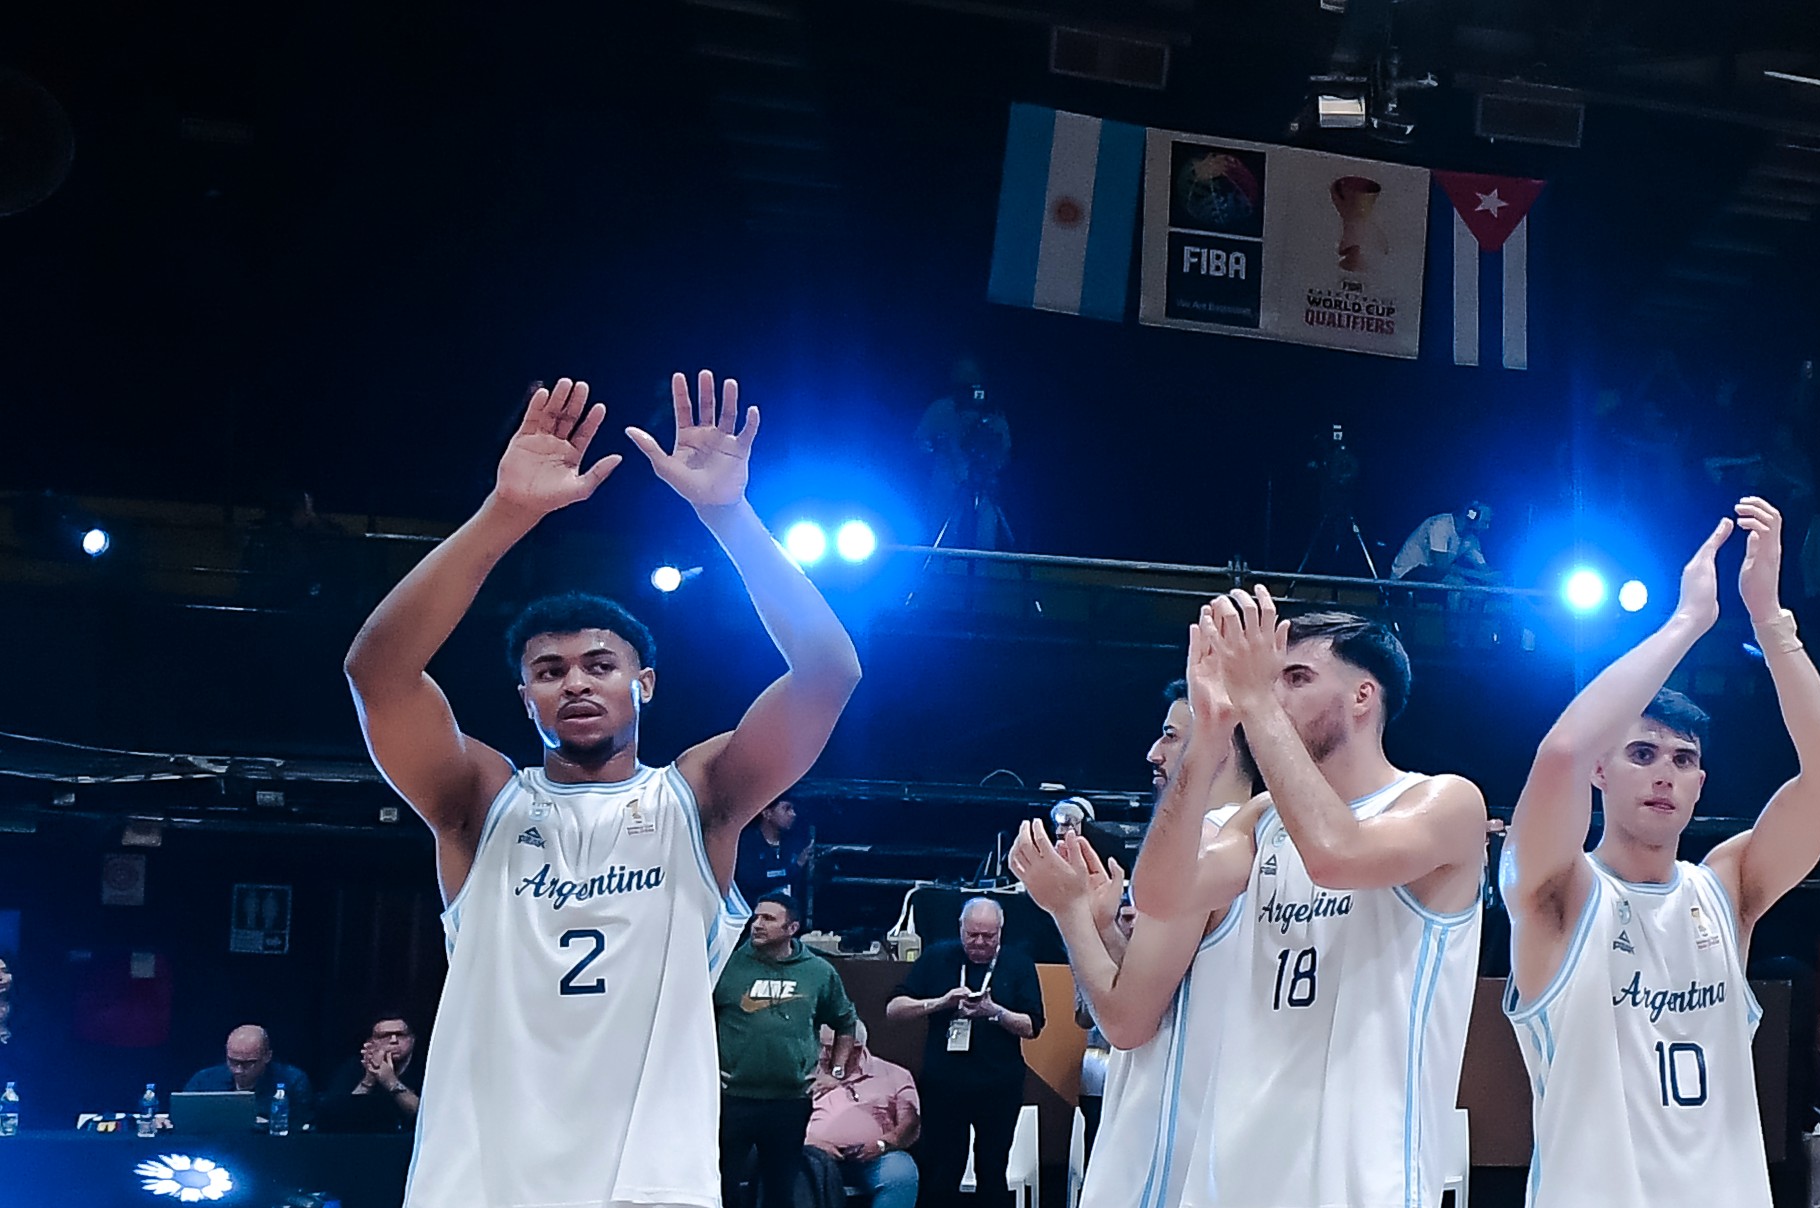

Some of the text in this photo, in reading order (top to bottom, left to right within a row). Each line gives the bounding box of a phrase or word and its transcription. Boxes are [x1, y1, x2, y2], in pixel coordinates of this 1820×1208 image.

[1183, 245, 1247, 280] FIBA
[1304, 309, 1395, 335] QUALIFIERS
[1307, 294, 1396, 317] WORLD CUP
[515, 864, 665, 910] Argentina
[558, 929, 606, 996] 2
[1273, 946, 1318, 1010] 18
[1655, 1041, 1707, 1106] 10
